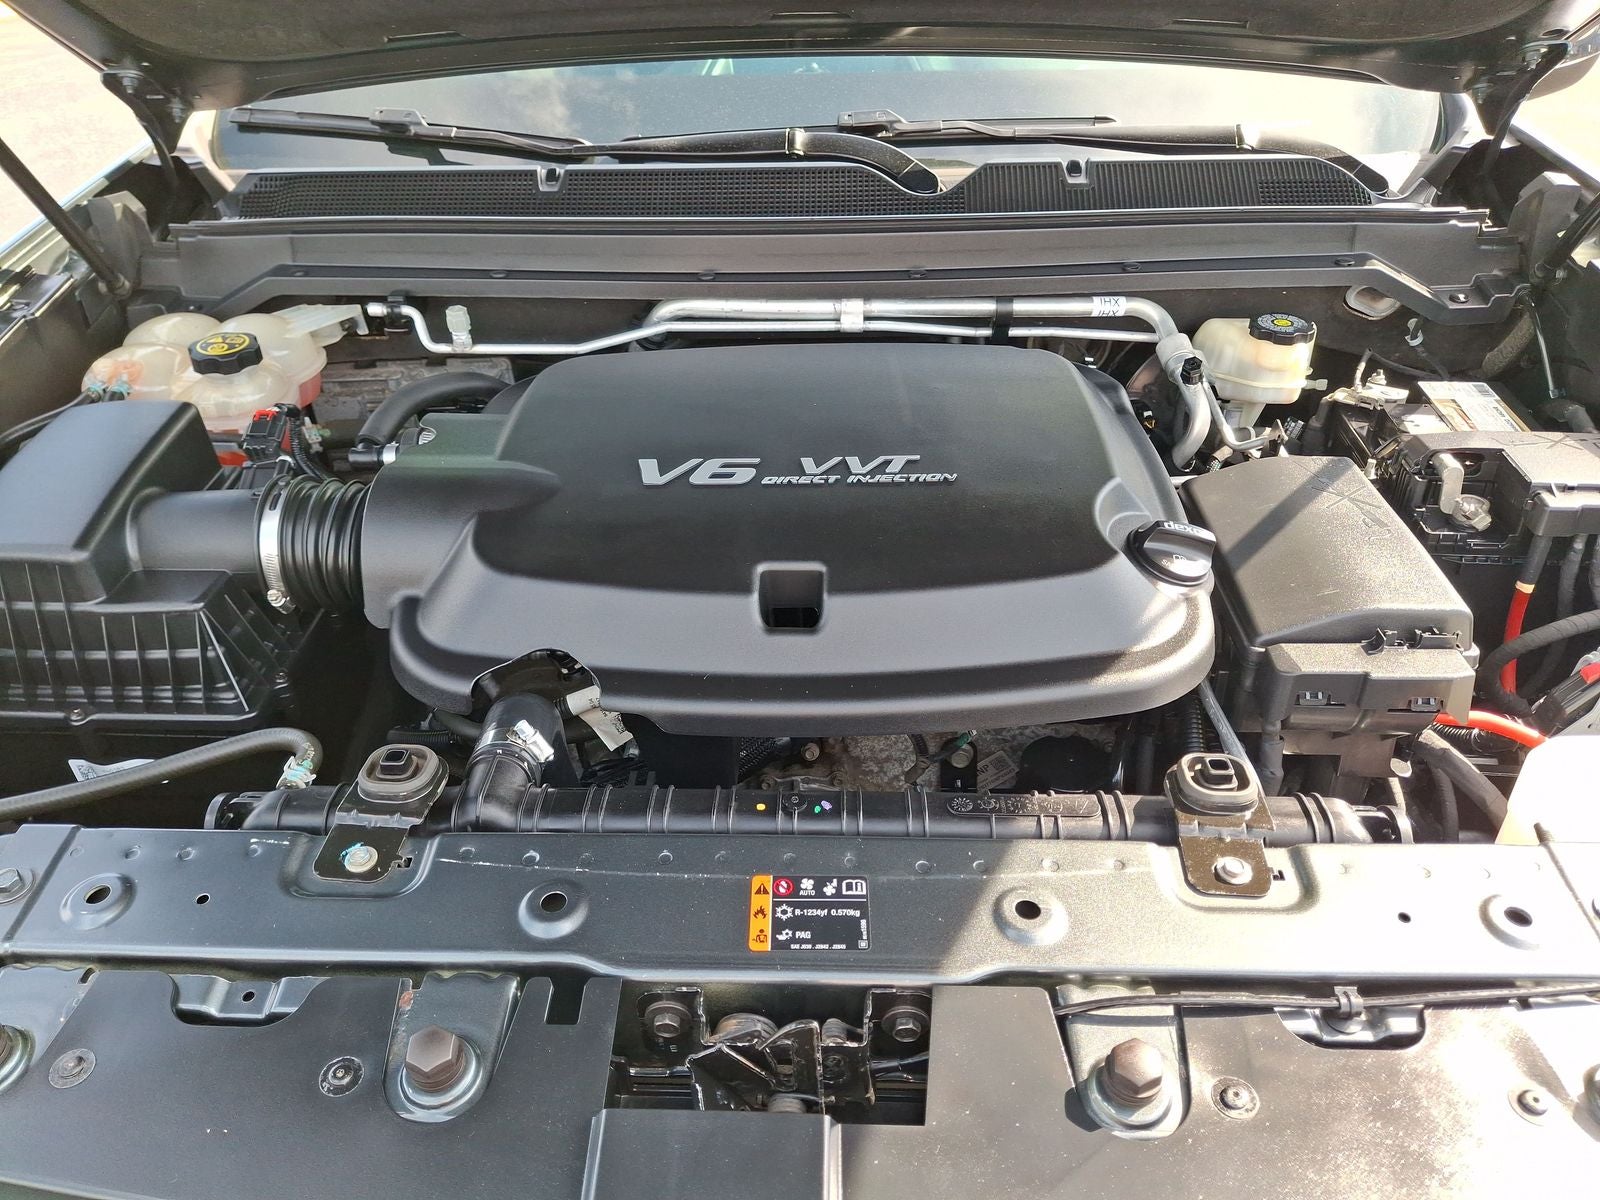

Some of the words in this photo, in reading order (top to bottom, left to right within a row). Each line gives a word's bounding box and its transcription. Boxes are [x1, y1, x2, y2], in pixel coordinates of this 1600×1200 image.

[800, 455, 921, 474] VVT
[638, 457, 761, 486] V6
[761, 475, 841, 485] DIRECT
[846, 473, 957, 485] INJECTION
[794, 909, 828, 917] R-1234yf
[831, 909, 860, 917] 0.570kg
[795, 931, 811, 939] PAG
